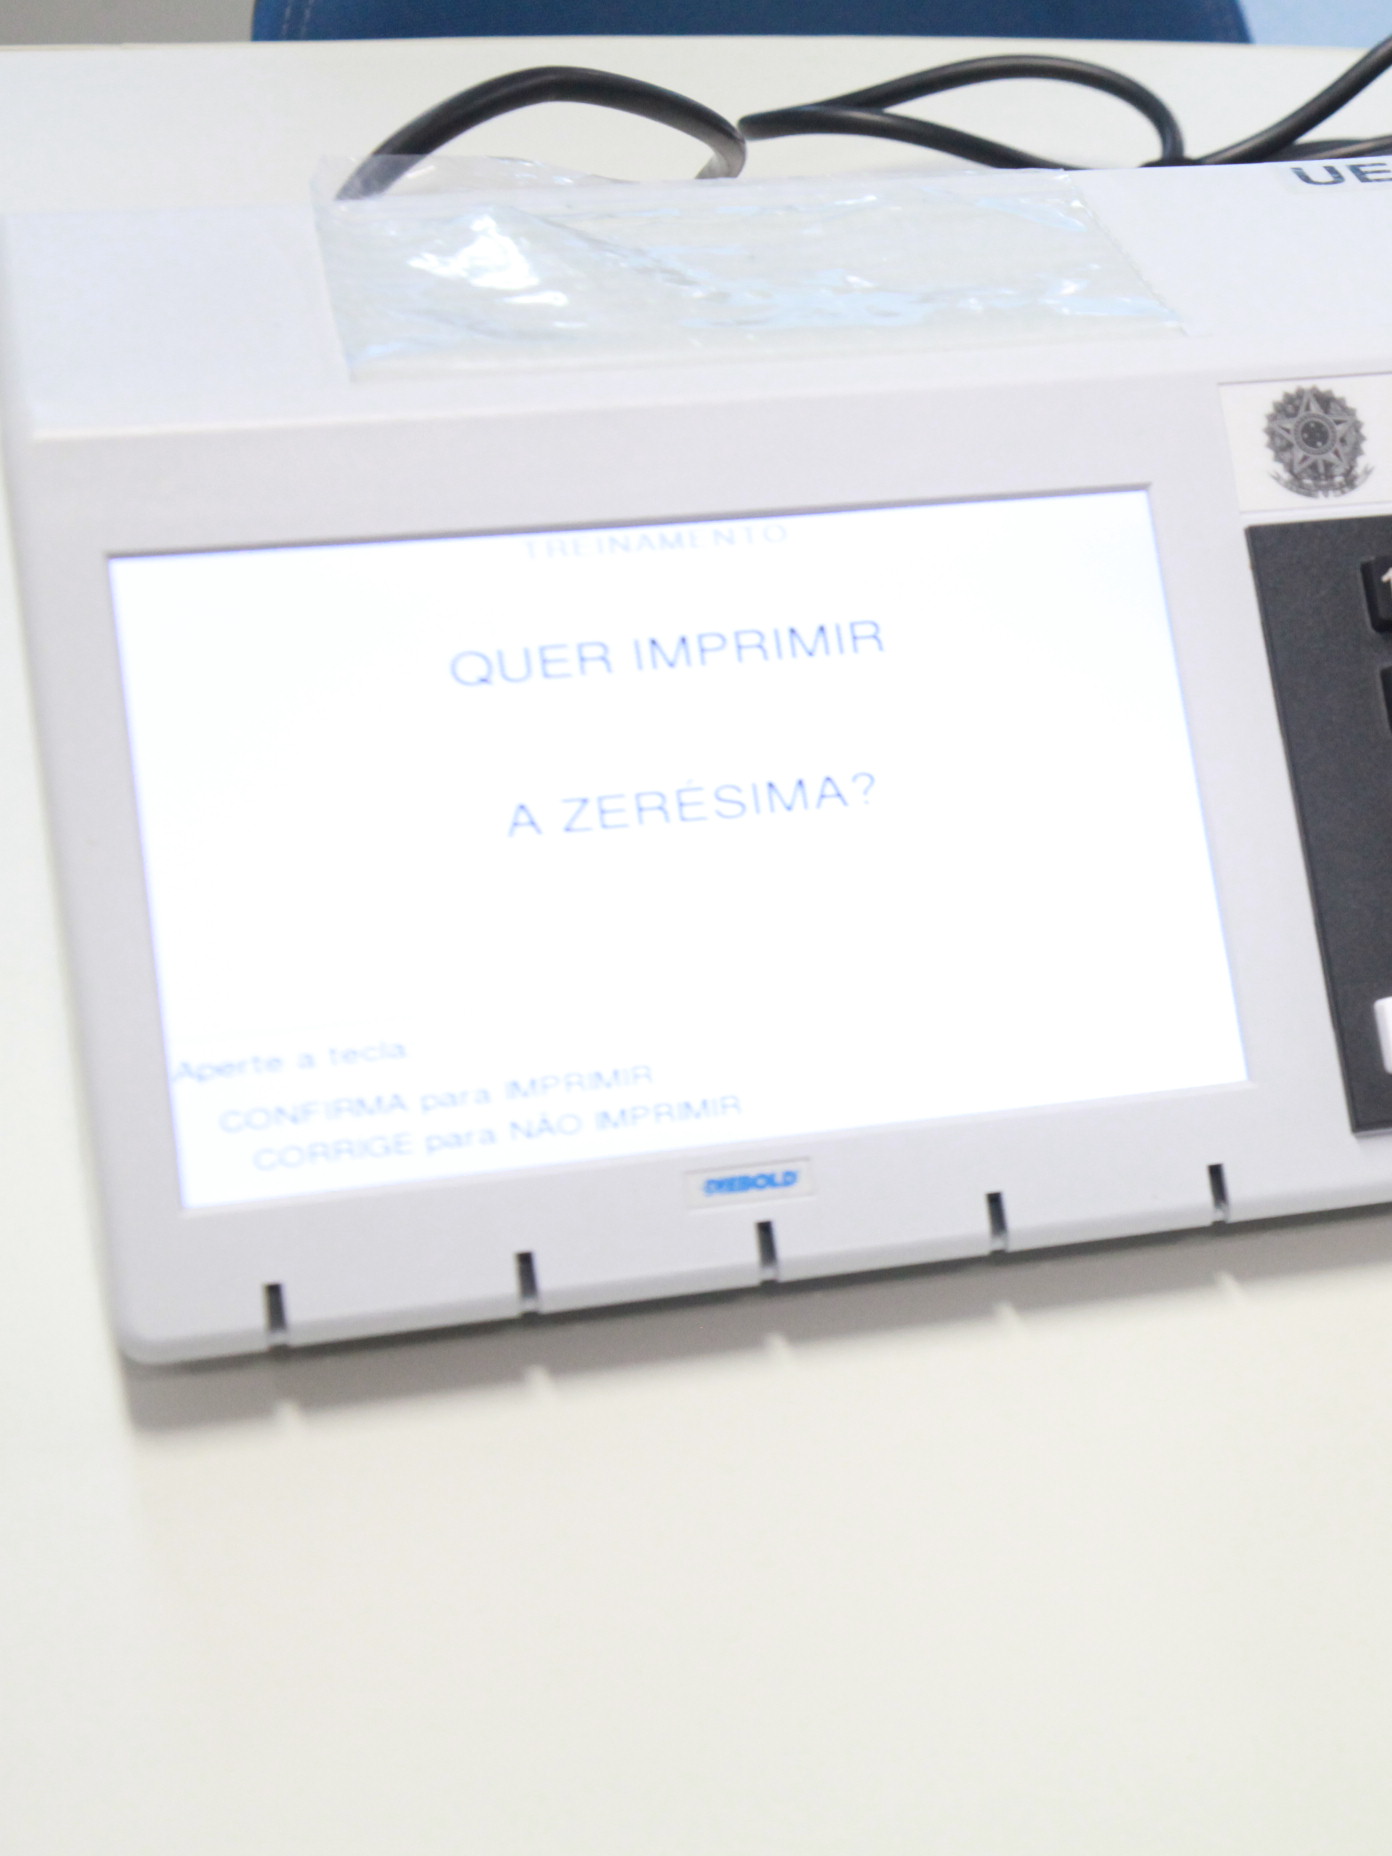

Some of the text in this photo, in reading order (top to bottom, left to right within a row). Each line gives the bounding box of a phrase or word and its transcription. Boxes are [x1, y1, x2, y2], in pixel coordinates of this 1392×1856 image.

[449, 619, 887, 688] QUER IMPRIMIR
[506, 771, 876, 838] A ZERÉSIMA?
[172, 1039, 408, 1083] Aperte a tecla
[218, 1065, 653, 1133] CONFIRMA para IMPRIMIR
[252, 1094, 743, 1171] CORRIGE para NÃO IMPRIMIR
